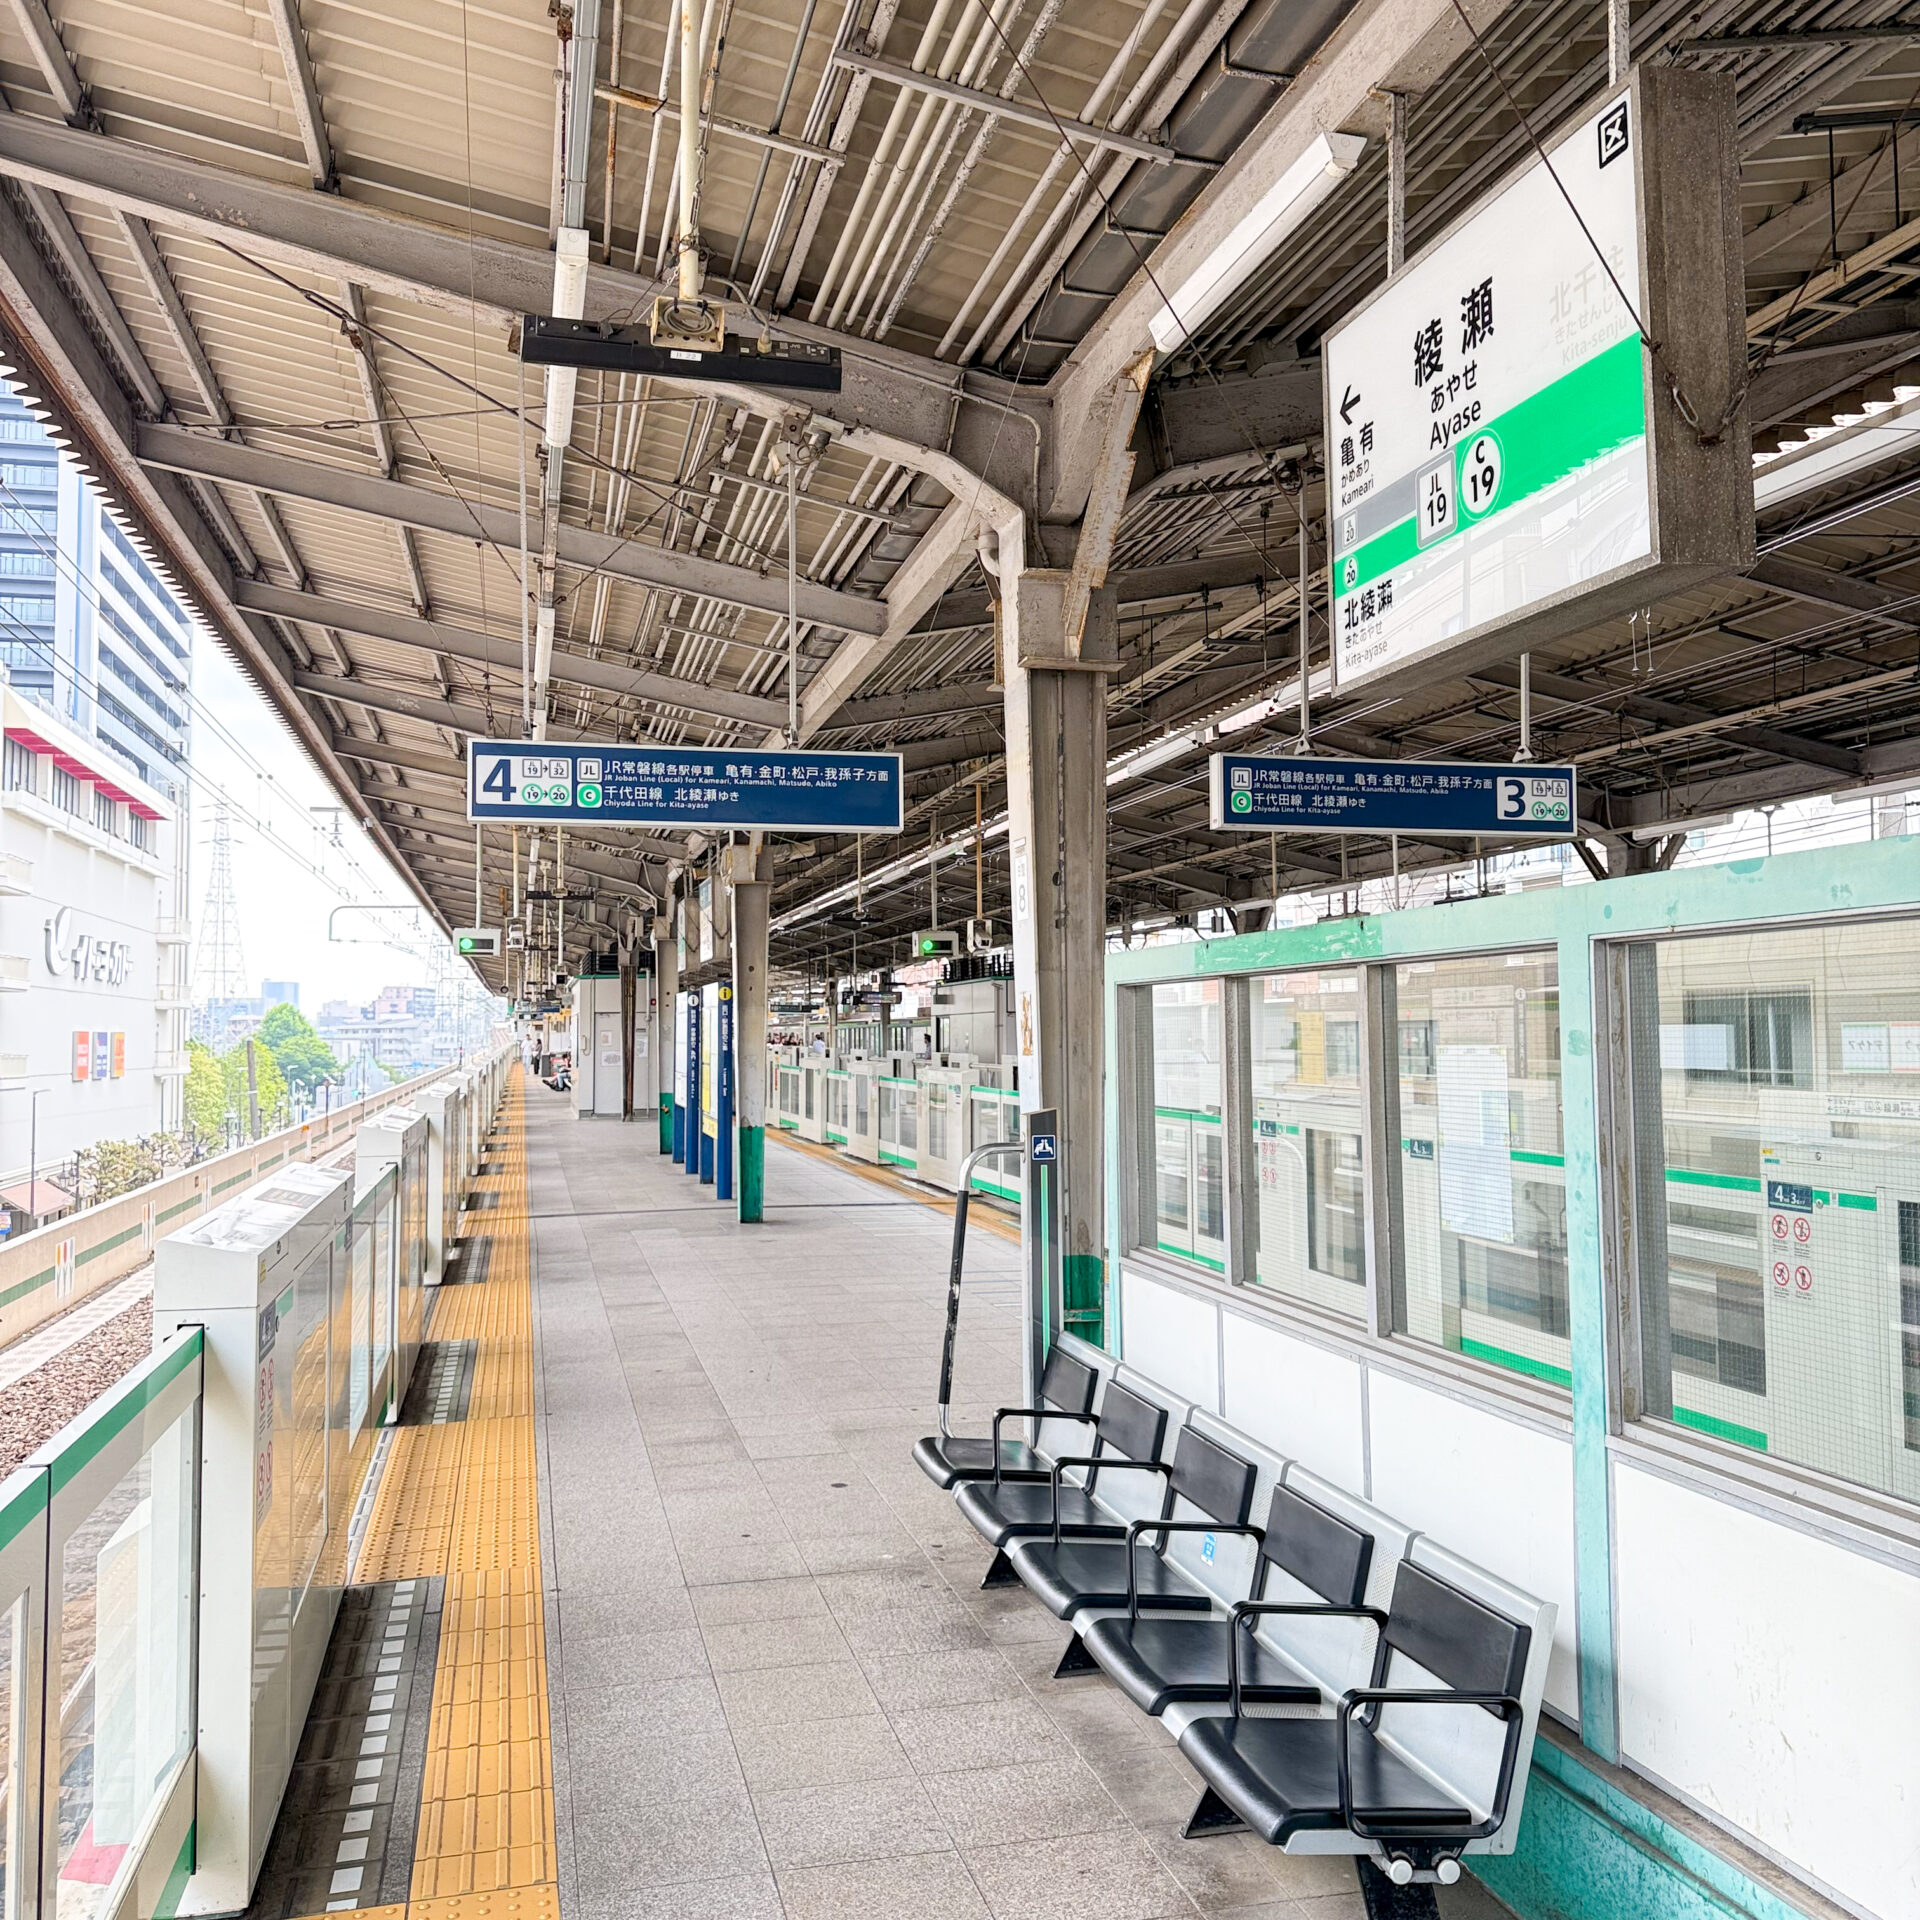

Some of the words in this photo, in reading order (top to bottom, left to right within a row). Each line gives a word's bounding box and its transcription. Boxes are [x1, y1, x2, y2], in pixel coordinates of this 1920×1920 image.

[1414, 276, 1495, 388] 綾瀬
[1562, 314, 1628, 365] Kita-senju
[1431, 359, 1478, 414] あやせ
[1430, 400, 1482, 450] Ayase
[1340, 420, 1374, 468] 亀有
[1475, 440, 1485, 464] C
[1341, 459, 1371, 489] かめあり
[1430, 472, 1442, 496] JL
[1470, 465, 1495, 503] 19
[1341, 474, 1375, 508] Kameari
[1427, 492, 1447, 527] 19
[1346, 527, 1355, 542] 20
[1346, 566, 1356, 584] 20
[1348, 559, 1353, 569] C
[1344, 578, 1393, 630] 北綾瀬
[1344, 620, 1383, 649] きたあやせ
[1345, 640, 1388, 668] Kita-ayase
[483, 759, 516, 801] 4
[583, 765, 595, 775] JL
[658, 776, 683, 784] (Local)
[699, 777, 732, 785] Kameari,
[734, 778, 776, 786] Kanamachi,
[779, 779, 813, 787] Matsudo,
[1236, 774, 1247, 783] JL
[553, 792, 565, 800] 20
[604, 786, 662, 800] 千代田線
[674, 787, 740, 802] 北綾瀬ゆき
[604, 800, 635, 808] Chiyoda
[670, 801, 709, 810] Kita-ayase
[1254, 793, 1302, 806] 千代田線
[1312, 795, 1366, 808] 北綾瀬ゆき
[1504, 779, 1525, 818] 3
[1254, 805, 1279, 813] Chiyoda
[1308, 807, 1341, 815] Kita-ayase
[1775, 1185, 1784, 1202] 4
[1790, 1192, 1797, 1204] 3
